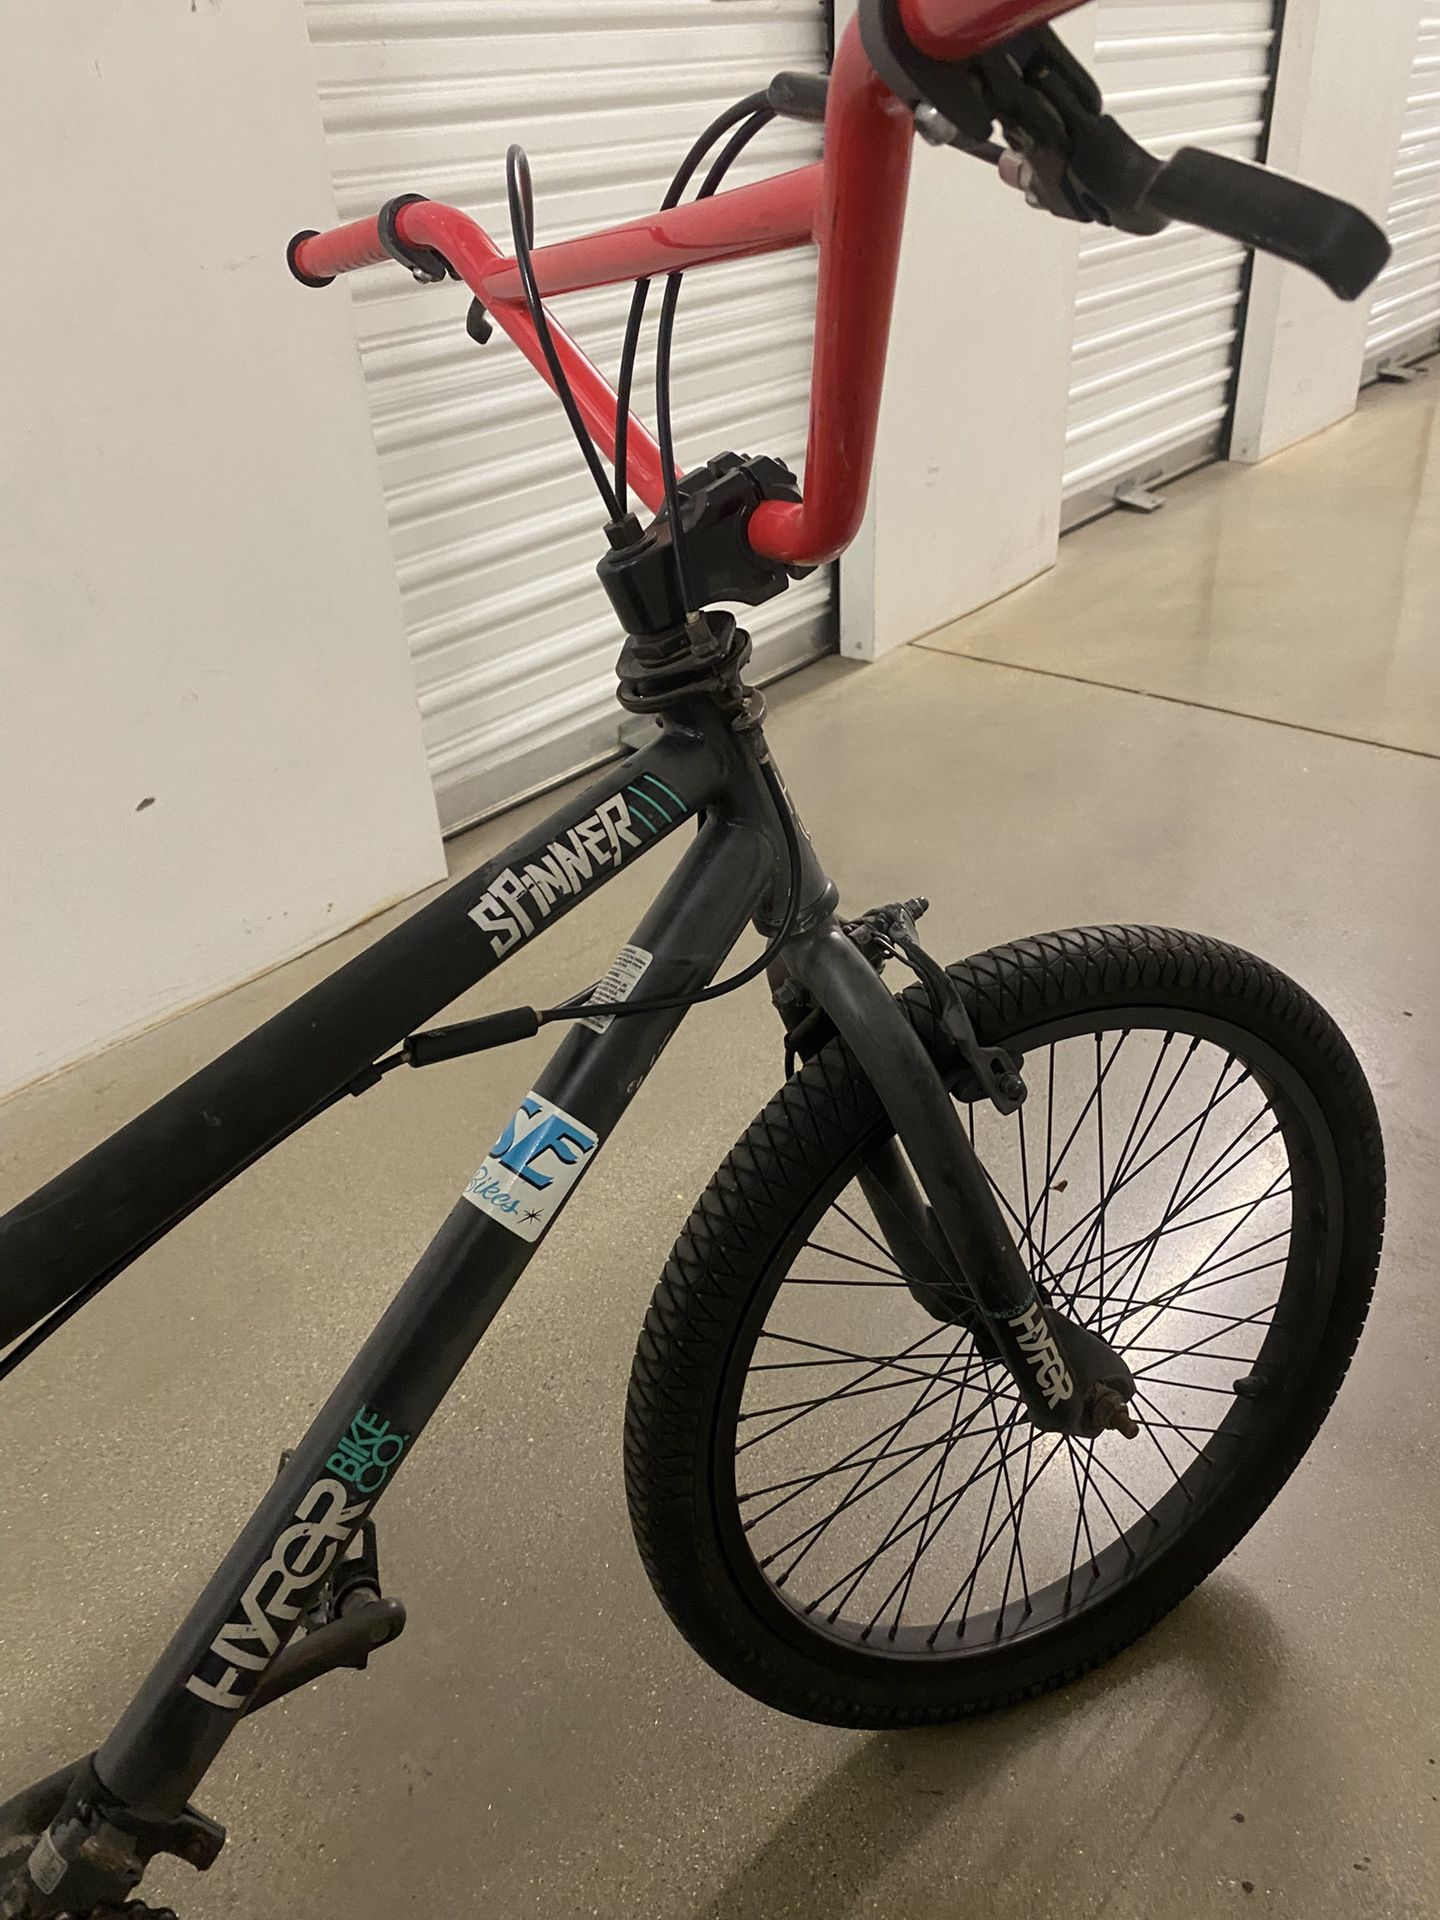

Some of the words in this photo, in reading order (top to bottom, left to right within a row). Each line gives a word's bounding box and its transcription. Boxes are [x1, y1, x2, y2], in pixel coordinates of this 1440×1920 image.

[467, 792, 643, 959] SPINNER
[464, 1166, 519, 1215] Bikes
[1008, 1302, 1074, 1410] HYPER
[325, 1402, 391, 1482] BIKE
[185, 1478, 371, 1710] HYPER
